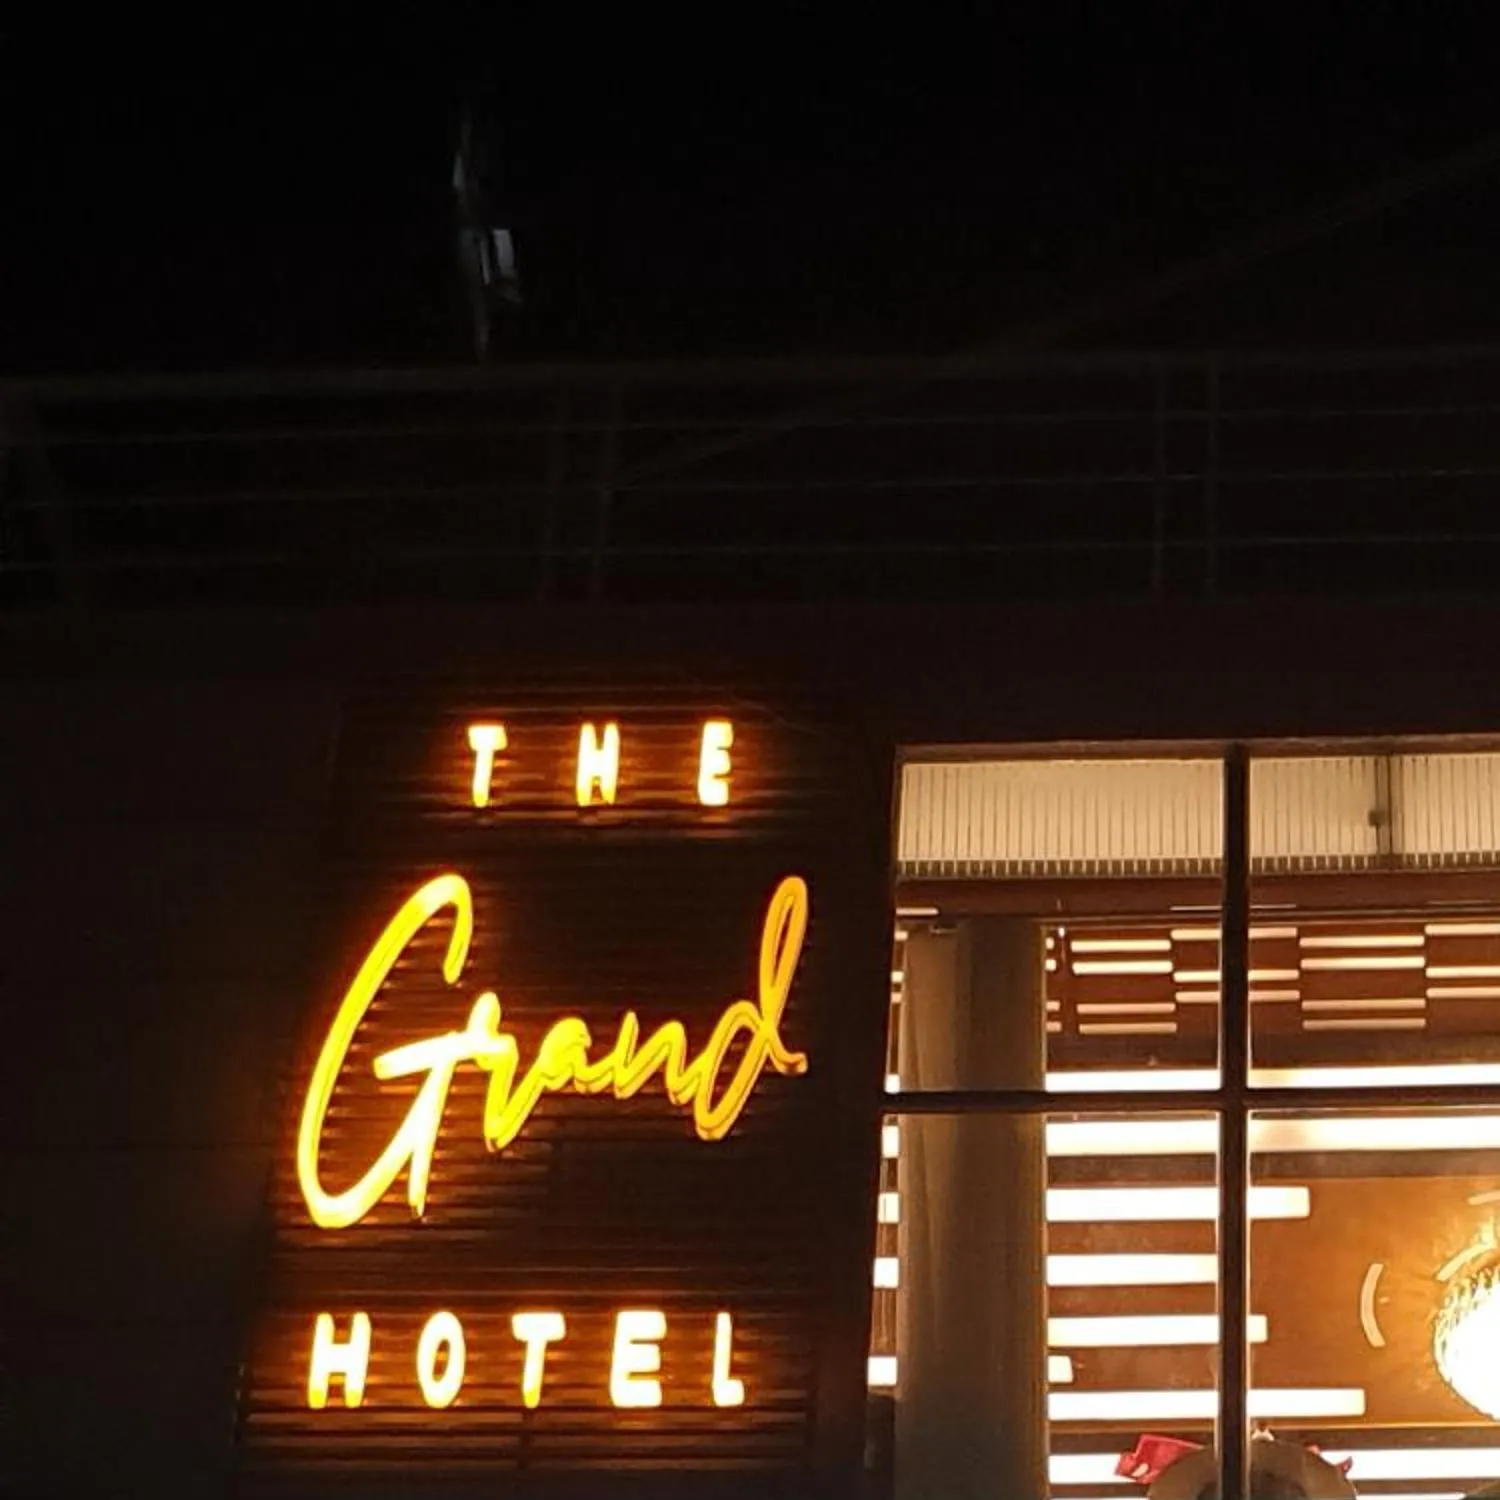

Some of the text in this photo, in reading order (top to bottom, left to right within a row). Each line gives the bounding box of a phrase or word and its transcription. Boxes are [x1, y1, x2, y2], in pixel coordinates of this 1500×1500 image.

[467, 720, 734, 808] THE
[296, 873, 808, 1229] Grand
[307, 1310, 746, 1409] HOTEL
